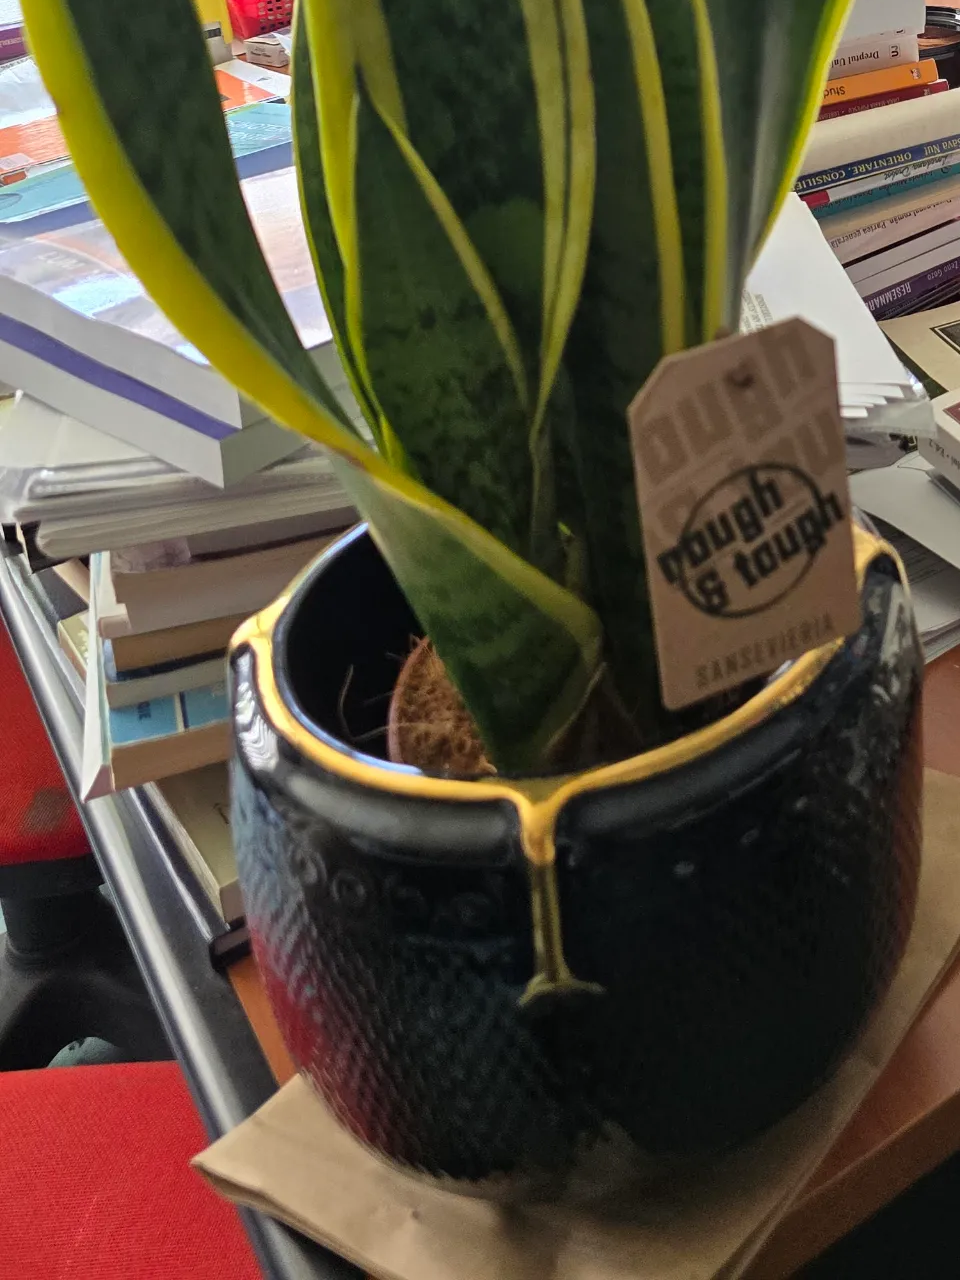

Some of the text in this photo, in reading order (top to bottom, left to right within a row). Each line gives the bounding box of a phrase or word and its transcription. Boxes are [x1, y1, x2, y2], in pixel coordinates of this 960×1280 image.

[848, 50, 880, 66] Dreptul
[848, 150, 912, 175] ORIENTARE,
[923, 142, 941, 156] Nut
[831, 220, 886, 248] Partea generală
[864, 260, 959, 313] Zeno Gozo RESEMNAR
[657, 469, 784, 585] rough
[732, 491, 847, 589] tough
